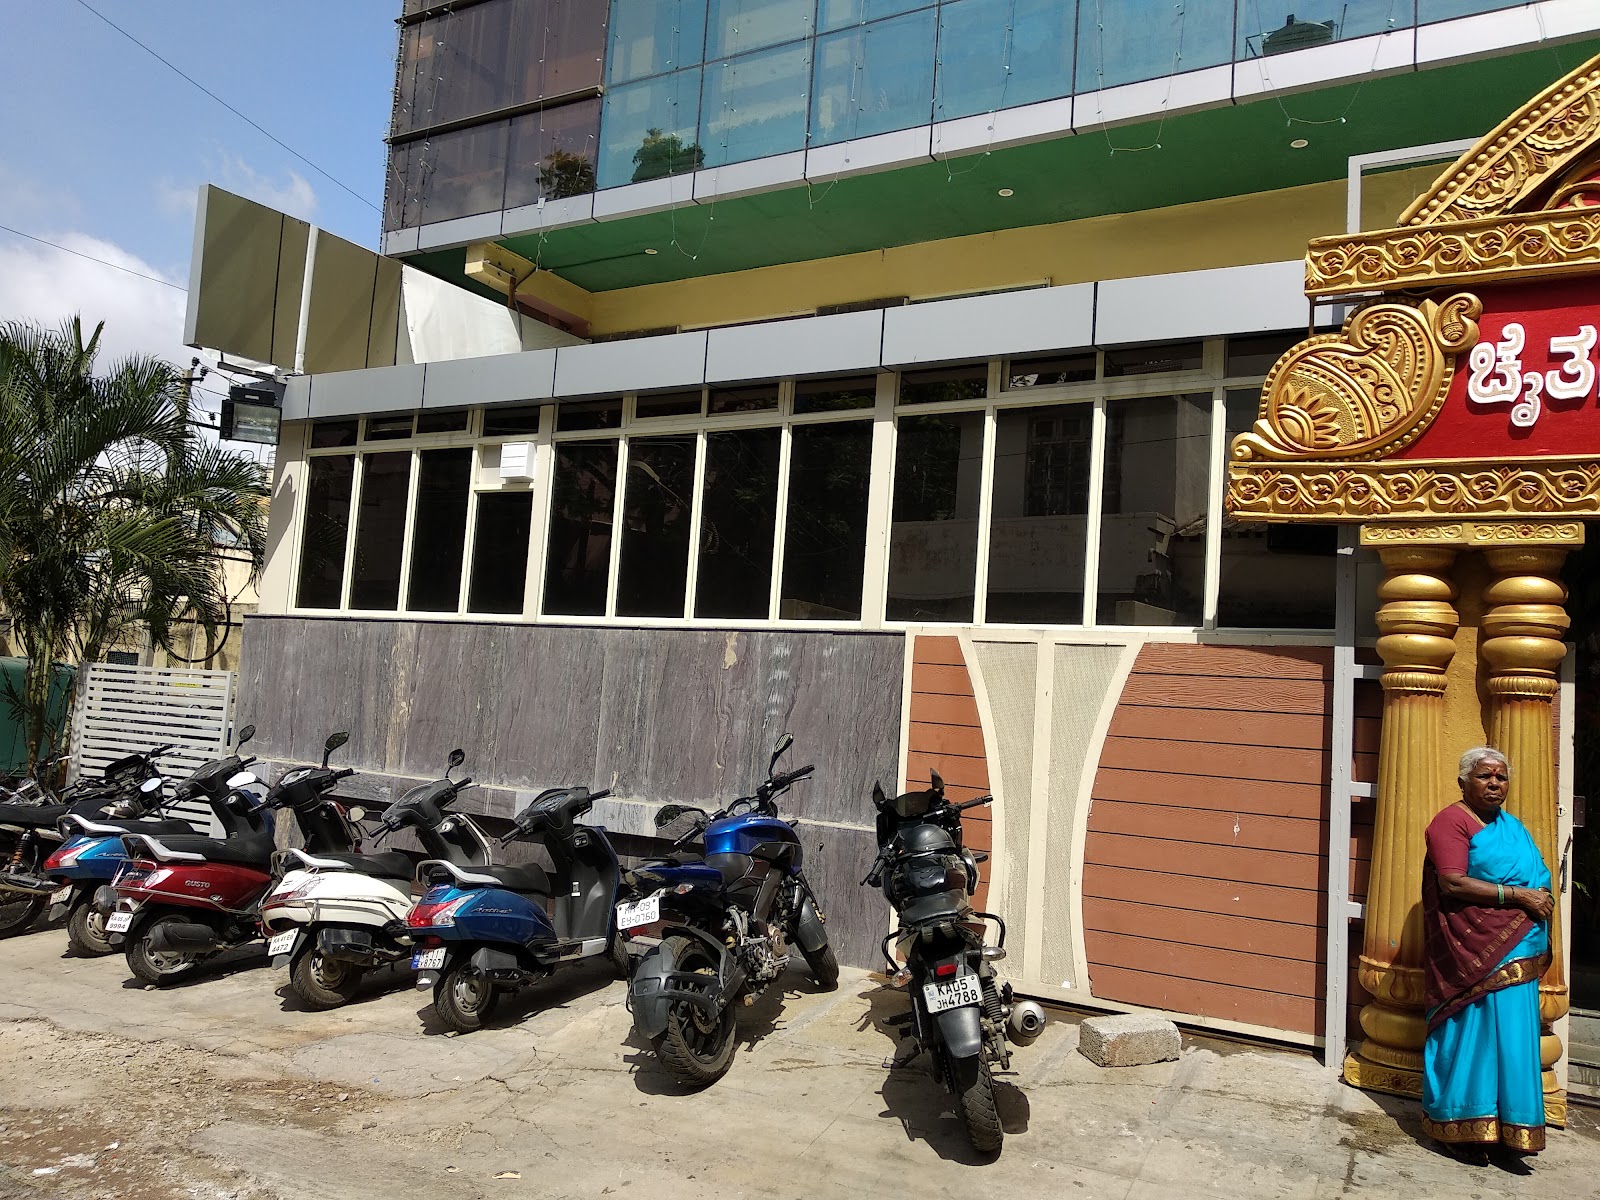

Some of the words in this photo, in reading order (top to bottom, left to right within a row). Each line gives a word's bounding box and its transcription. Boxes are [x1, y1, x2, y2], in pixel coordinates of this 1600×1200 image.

[1467, 322, 1600, 428] ಚೈತ
[184, 879, 210, 889] GUSTO
[936, 978, 968, 996] KA05
[937, 989, 978, 1009] JH4788
